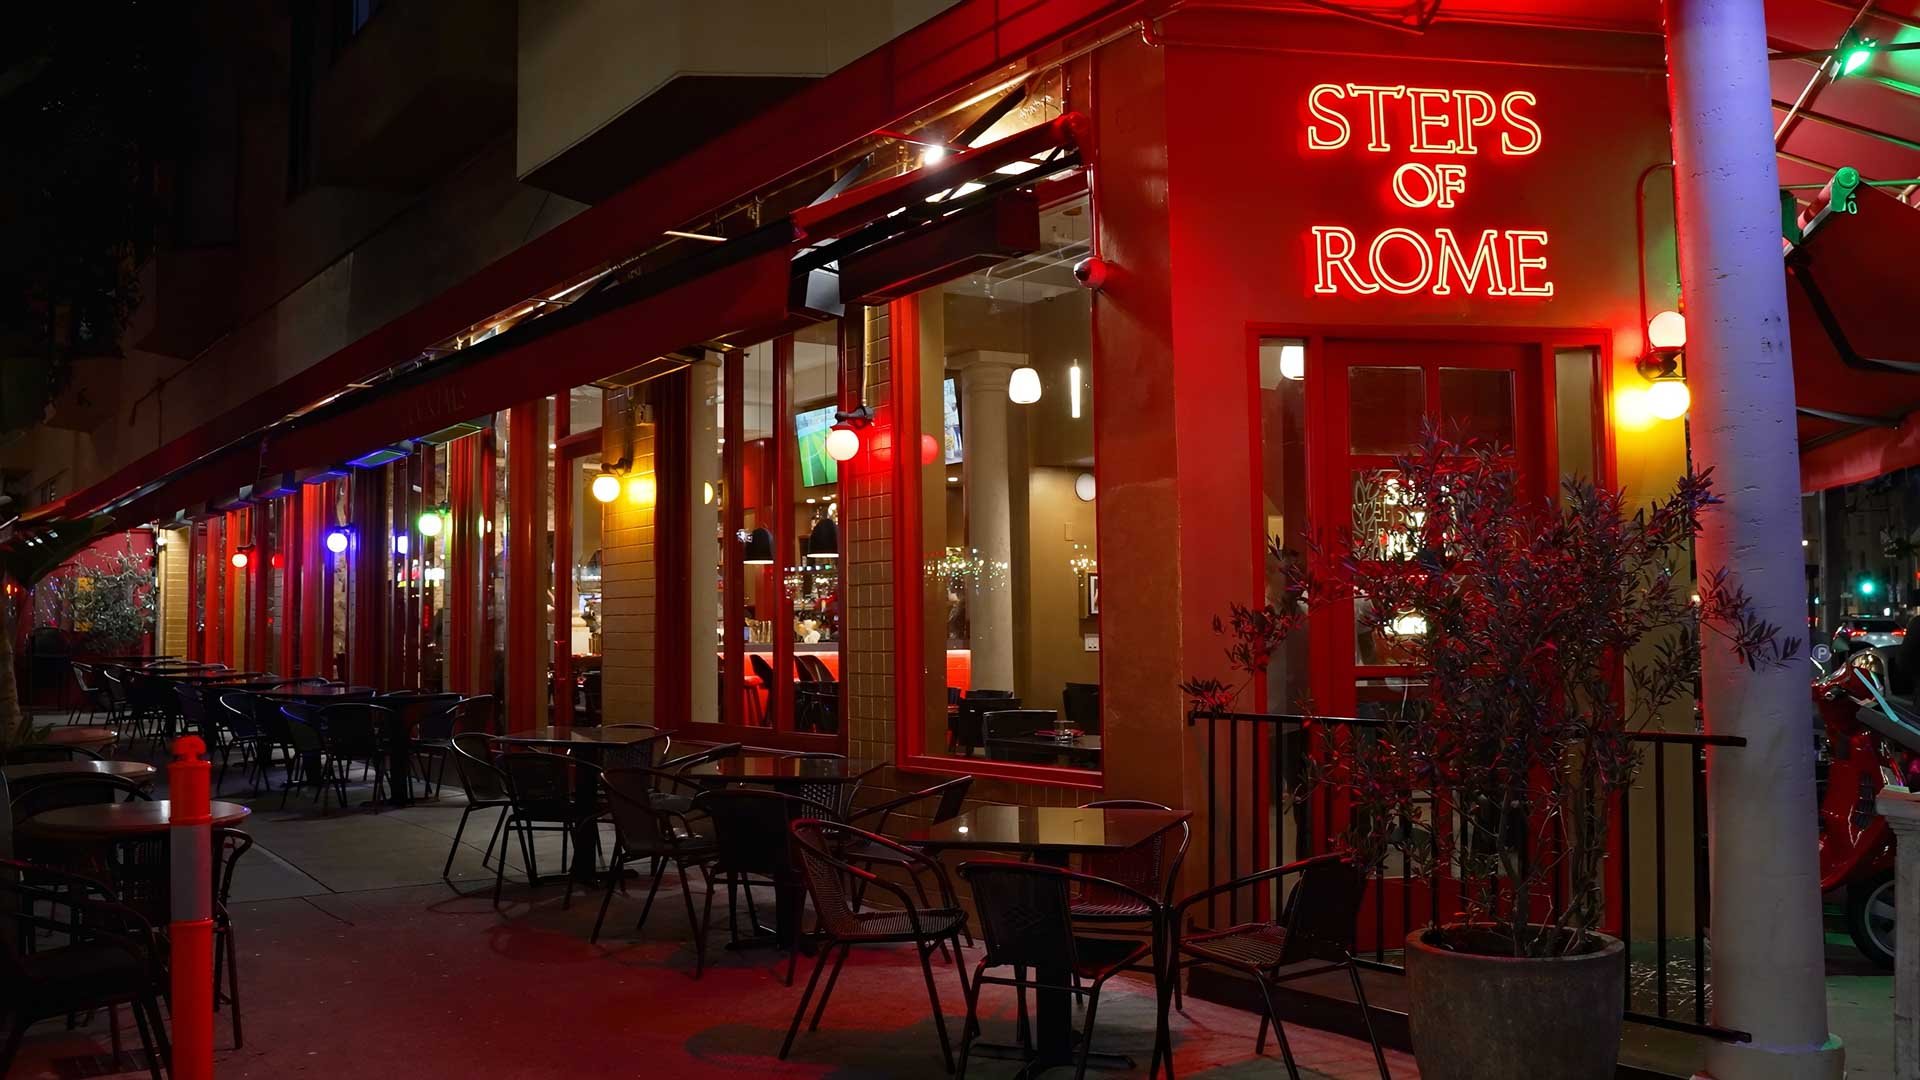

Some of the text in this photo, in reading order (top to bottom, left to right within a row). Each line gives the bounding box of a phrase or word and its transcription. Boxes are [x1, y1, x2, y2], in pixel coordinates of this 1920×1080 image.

[1307, 83, 1542, 155] STEPS
[1392, 162, 1467, 208] OF
[1311, 225, 1554, 296] ROME
